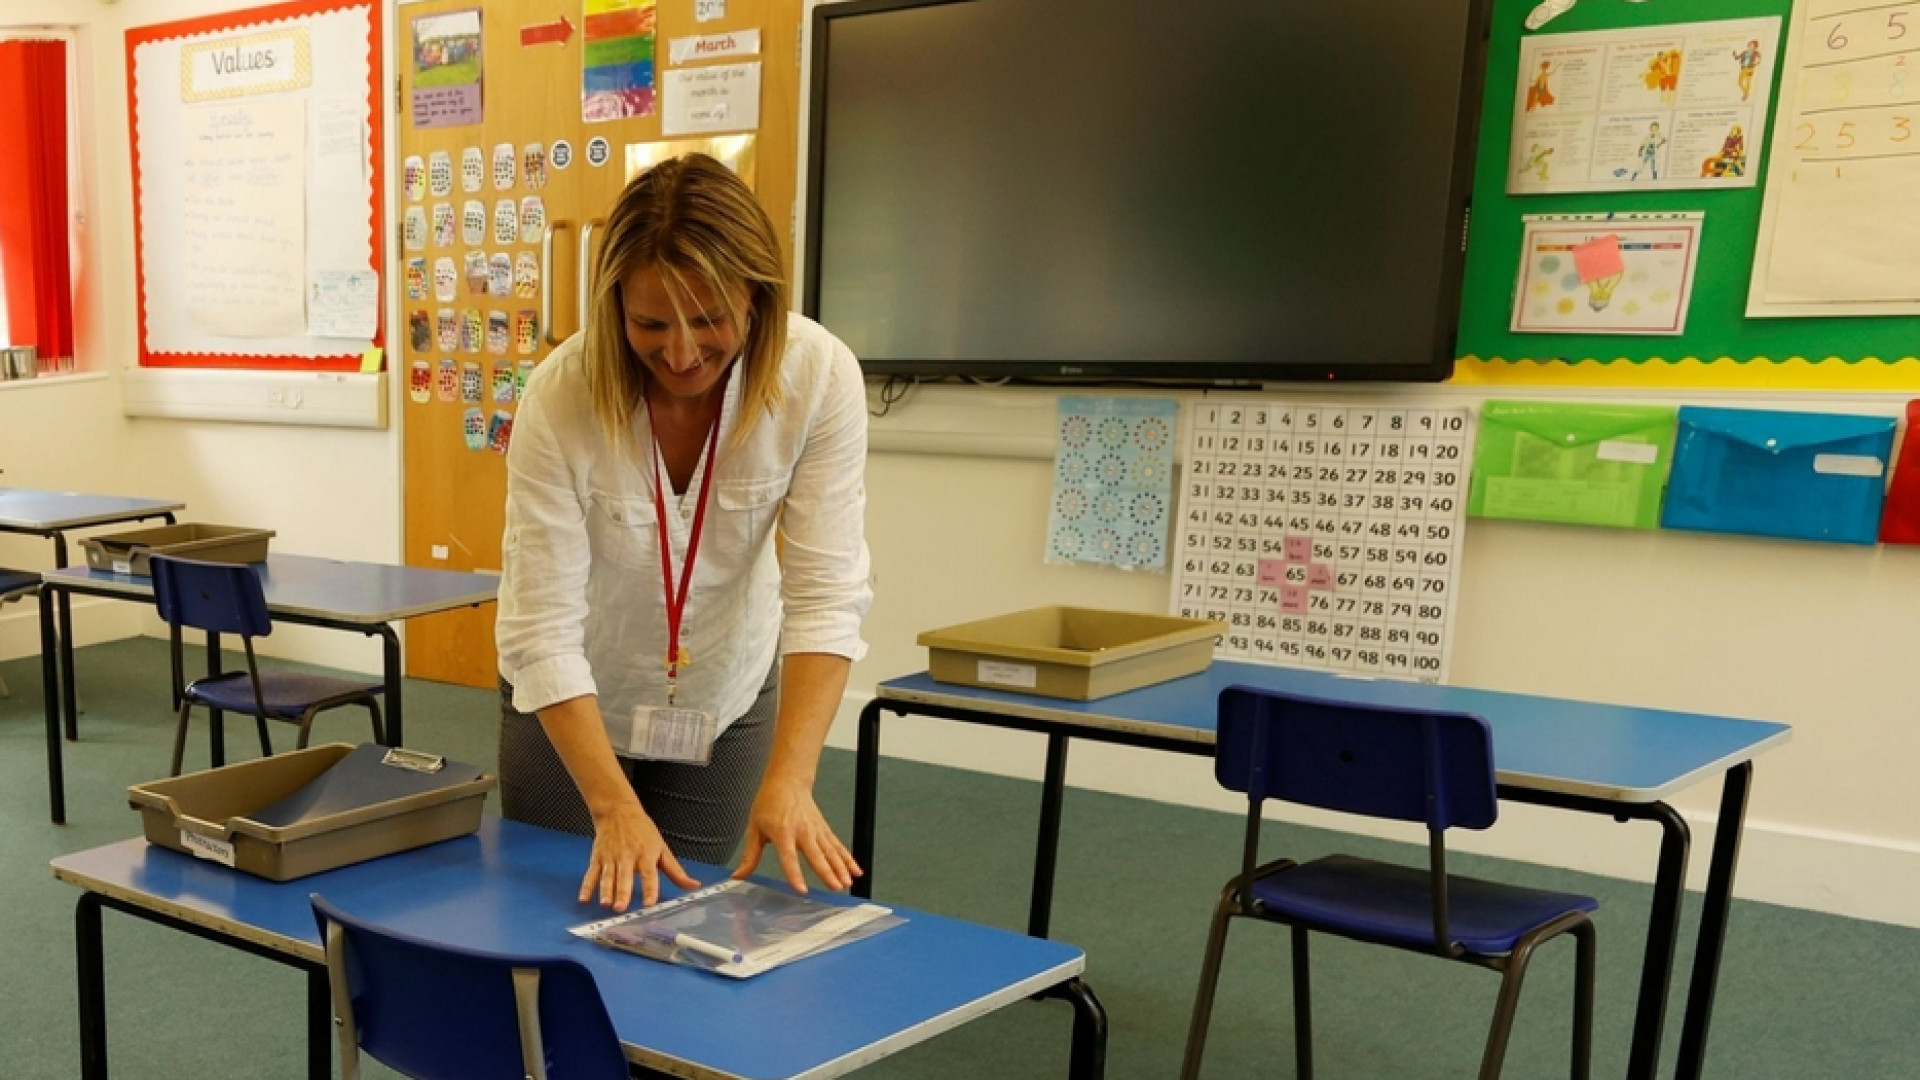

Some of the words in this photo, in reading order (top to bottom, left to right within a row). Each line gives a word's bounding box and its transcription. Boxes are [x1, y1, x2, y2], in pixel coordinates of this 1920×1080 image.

[696, 36, 736, 53] March
[1828, 22, 1848, 50] 6
[1888, 12, 1909, 40] 5
[212, 46, 274, 74] Values
[1830, 73, 1852, 105] 3
[1794, 122, 1820, 151] 2
[1836, 122, 1856, 148] 5
[1890, 116, 1912, 142] 3
[1210, 410, 1215, 422] 1
[1231, 411, 1240, 424] 2
[1256, 412, 1266, 424] 3
[1282, 413, 1291, 426] 4
[1307, 414, 1316, 428] 5
[1334, 416, 1343, 428] 6
[1363, 416, 1373, 428] 7
[1391, 416, 1402, 430] 8
[1420, 417, 1431, 430] 9
[1443, 418, 1462, 430] 10
[1198, 436, 1213, 448] 11
[1223, 438, 1238, 450] 12
[1248, 438, 1264, 451] 13
[1274, 440, 1289, 452] 14
[1299, 441, 1314, 454] 15
[1324, 442, 1340, 455] 16
[1352, 444, 1369, 456] 17
[1381, 444, 1398, 457] 18
[1410, 445, 1428, 457] 19
[1437, 446, 1458, 459] 20
[1194, 461, 1210, 473] 21
[1219, 463, 1236, 475] 22
[1243, 463, 1262, 477] 23
[1268, 465, 1287, 477] 24
[1293, 467, 1312, 479] 25
[1320, 468, 1338, 481] 26
[1346, 469, 1367, 482] 27
[1375, 471, 1396, 483] 28
[1404, 471, 1425, 484] 29
[1435, 473, 1455, 486] 30
[1192, 484, 1209, 496] 31
[1217, 486, 1234, 499] 32
[1242, 488, 1260, 500] 33
[1268, 490, 1285, 502] 34
[1291, 491, 1311, 504] 35
[1318, 492, 1336, 506] 36
[1344, 494, 1365, 506] 37
[1373, 496, 1394, 508] 38
[1400, 498, 1422, 510] 39
[1430, 498, 1452, 512] 40
[1190, 510, 1207, 522] 41
[1215, 512, 1233, 525] 42
[1240, 514, 1258, 527] 43
[1264, 516, 1283, 528] 44
[1290, 518, 1309, 531] 45
[1316, 520, 1334, 533] 46
[1342, 522, 1362, 533] 47
[1369, 524, 1390, 537] 48
[1398, 525, 1419, 537] 49
[1427, 526, 1449, 539] 50
[1188, 535, 1205, 547] 51
[1213, 537, 1232, 549] 52
[1238, 539, 1256, 551] 53
[1264, 541, 1281, 552] 54
[1314, 545, 1332, 558] 56
[1340, 546, 1359, 559] 57
[1367, 549, 1388, 562] 58
[1396, 550, 1416, 563] 59
[1424, 553, 1447, 566] 60
[1186, 560, 1203, 572] 61
[1211, 562, 1229, 574] 62
[1236, 564, 1254, 576] 63
[1285, 568, 1305, 580] 65
[1338, 574, 1357, 585] 67
[1365, 576, 1386, 588] 68
[1392, 578, 1414, 590] 69
[1423, 579, 1443, 592] 70
[1184, 584, 1201, 596] 71
[1211, 586, 1227, 599] 72
[1235, 588, 1252, 601] 73
[1260, 591, 1278, 603] 74
[1311, 596, 1328, 609] 76
[1336, 599, 1355, 611] 77
[1363, 601, 1383, 615] 78
[1392, 603, 1411, 617] 79
[1418, 605, 1441, 619] 80
[1232, 613, 1250, 626] 83
[1257, 615, 1276, 628] 84
[1283, 619, 1301, 632] 85
[1307, 621, 1327, 634] 86
[1334, 624, 1353, 636] 87
[1360, 627, 1381, 640] 88
[1388, 630, 1408, 642] 89
[1416, 632, 1439, 646] 90
[1229, 636, 1248, 650] 93
[1254, 640, 1273, 652] 94
[1280, 642, 1299, 655] 95
[1305, 646, 1324, 658] 96
[1332, 648, 1351, 660] 97
[1358, 650, 1378, 664] 98
[1386, 654, 1406, 666] 99
[1414, 656, 1439, 670] 100
